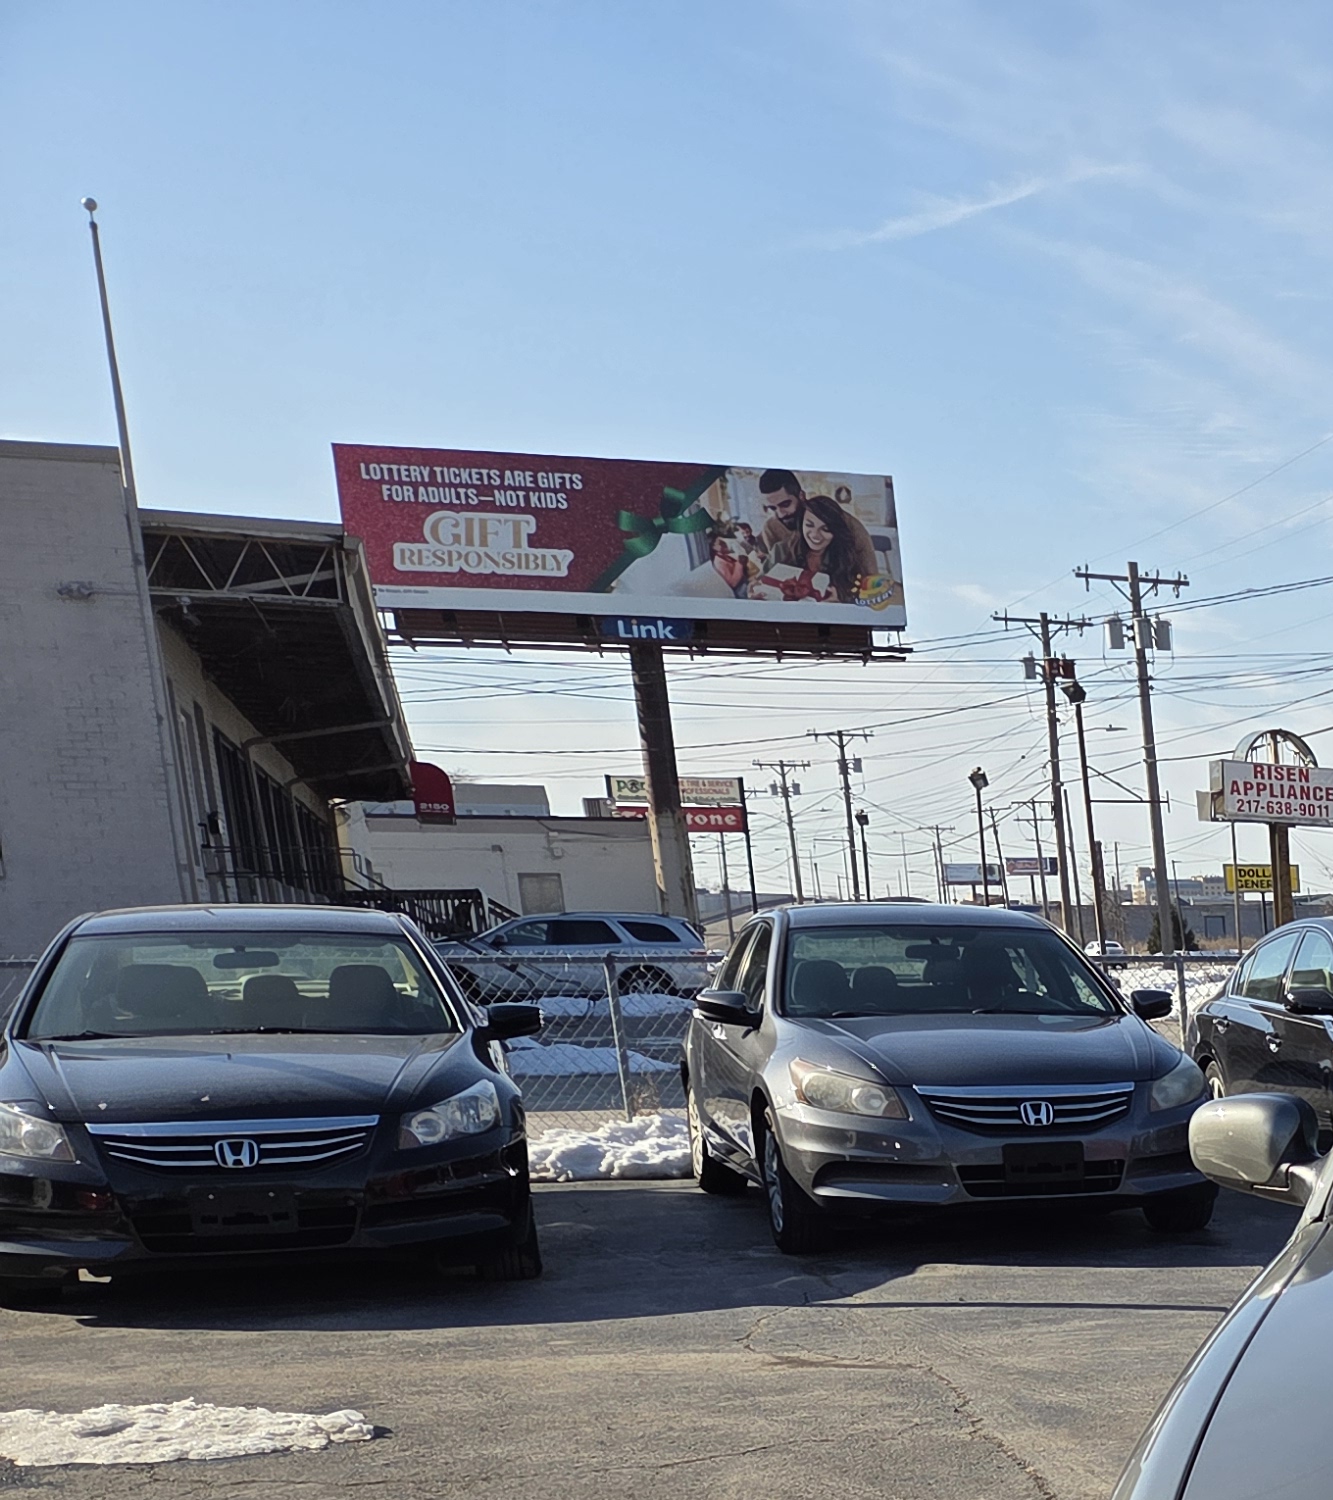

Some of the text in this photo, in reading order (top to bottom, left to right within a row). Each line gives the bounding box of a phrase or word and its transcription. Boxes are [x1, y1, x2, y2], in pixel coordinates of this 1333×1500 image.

[360, 463, 583, 489] LOTTERY TICKETS ARE GIFTS
[382, 484, 414, 502] FOR
[529, 492, 568, 509] KIDS
[430, 516, 530, 548] GIFT
[399, 548, 568, 571] RESPONSIBLY
[617, 619, 679, 640] Link
[1253, 764, 1310, 783] RISEN
[1236, 798, 1329, 818] 217-638-9011
[1238, 868, 1272, 878] DOLL
[1238, 879, 1272, 889] GENER
